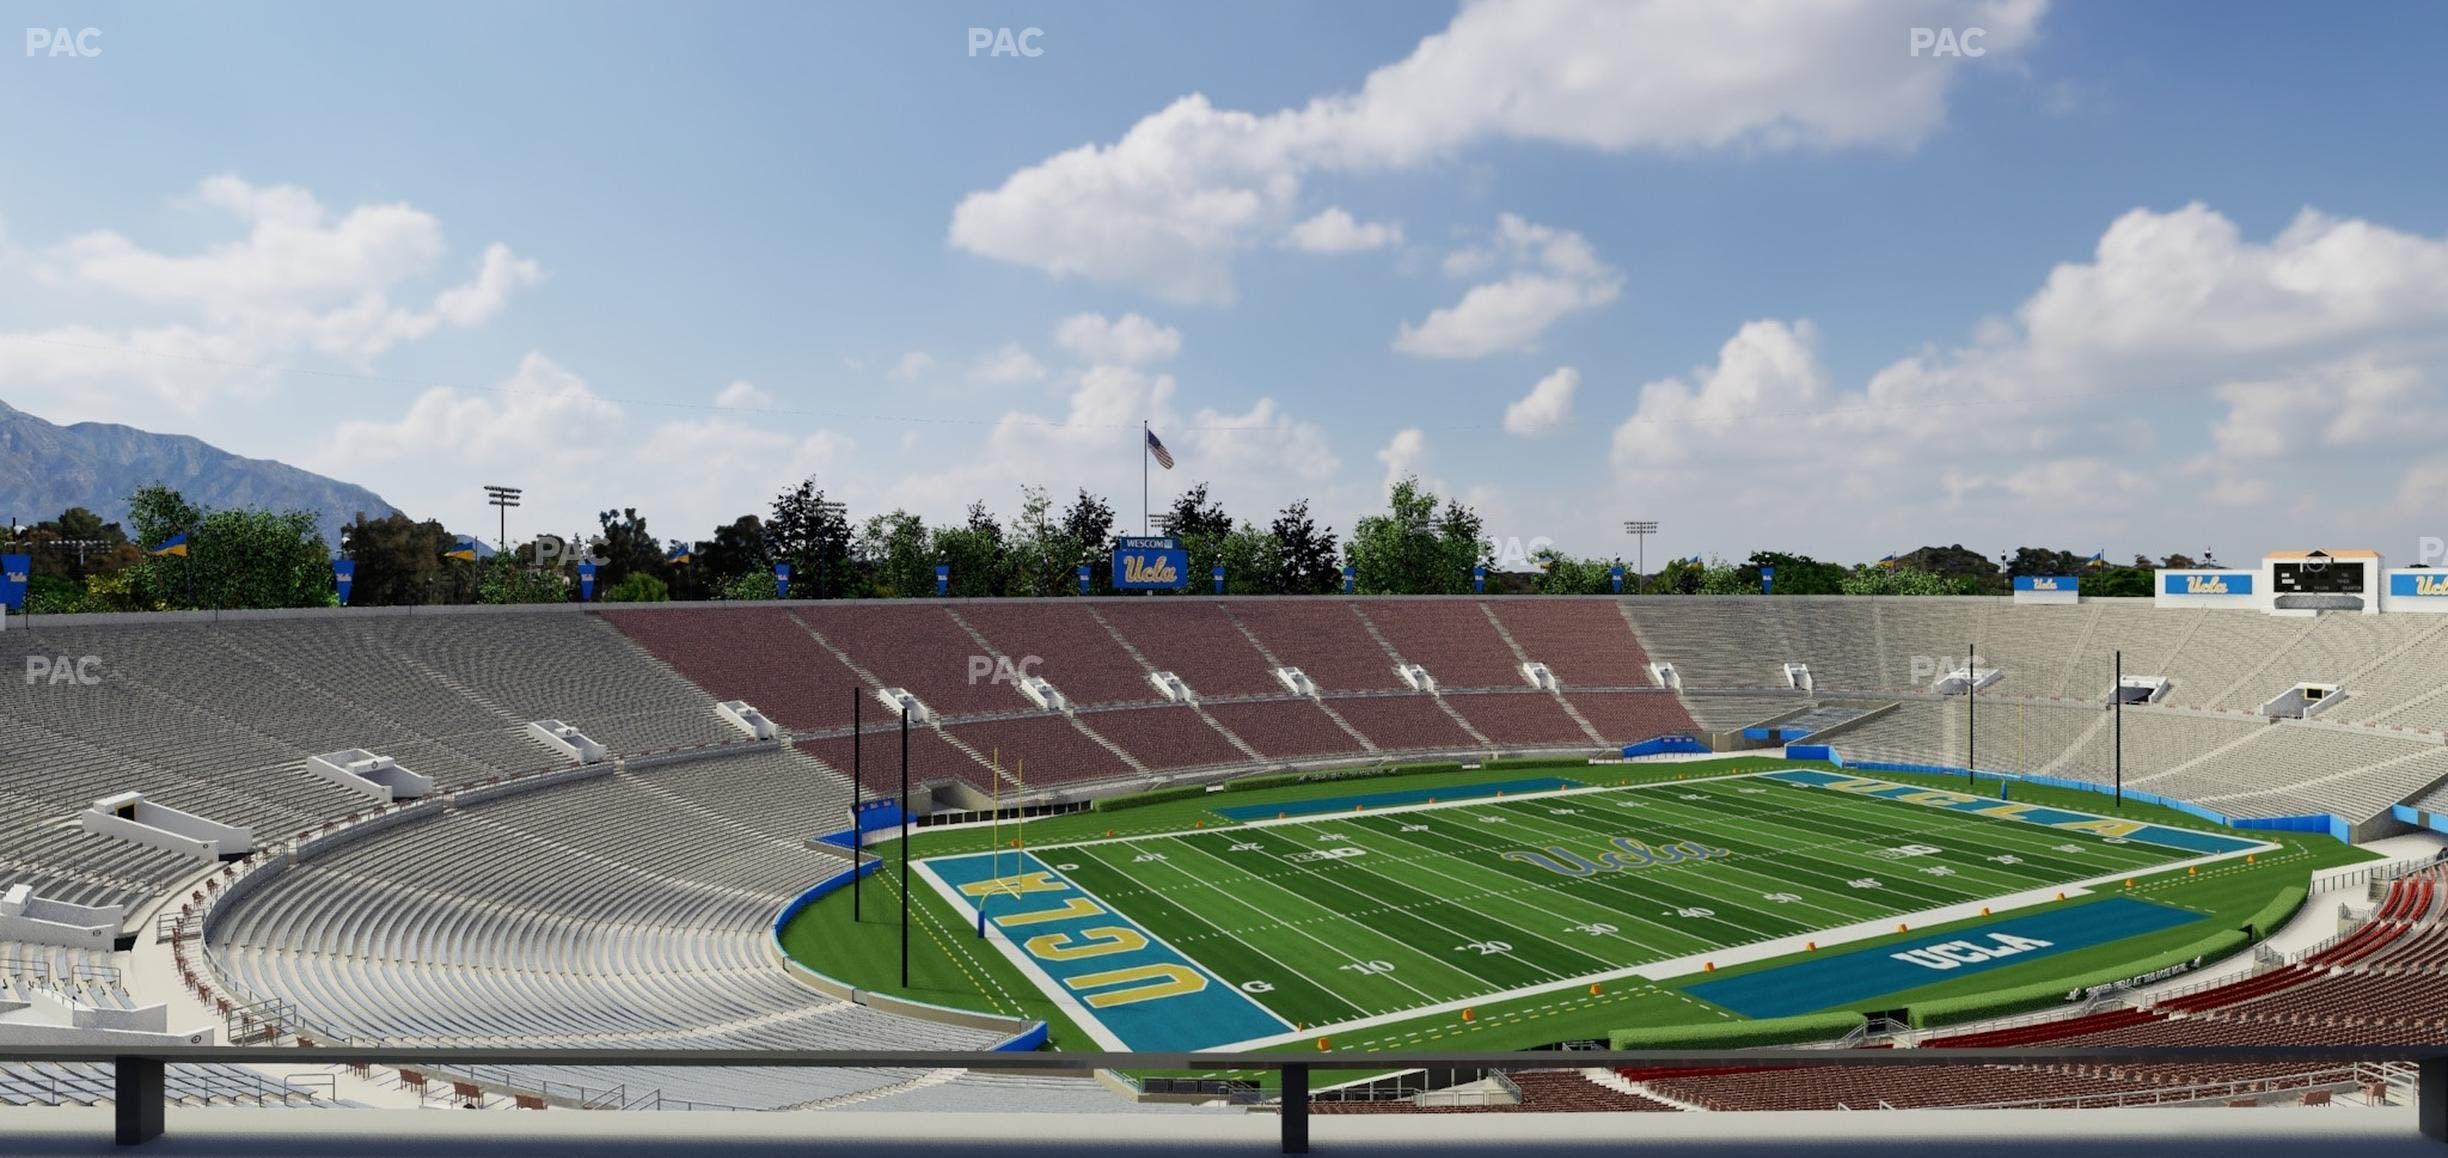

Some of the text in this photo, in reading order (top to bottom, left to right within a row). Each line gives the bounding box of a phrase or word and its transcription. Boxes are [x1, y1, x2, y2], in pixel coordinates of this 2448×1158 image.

[1126, 540, 1164, 548] WESCOM
[1123, 555, 1178, 583] Ucla
[2186, 575, 2229, 593] Ucla
[2416, 575, 2448, 595] Ucl
[1500, 836, 1731, 876] Ucla
[1576, 923, 1619, 936] 30
[957, 871, 1209, 1008] UCLA
[1467, 941, 1513, 955] 20
[1889, 932, 2055, 970] UCLA
[1348, 960, 1395, 976] 10
[1240, 980, 1276, 994] G
